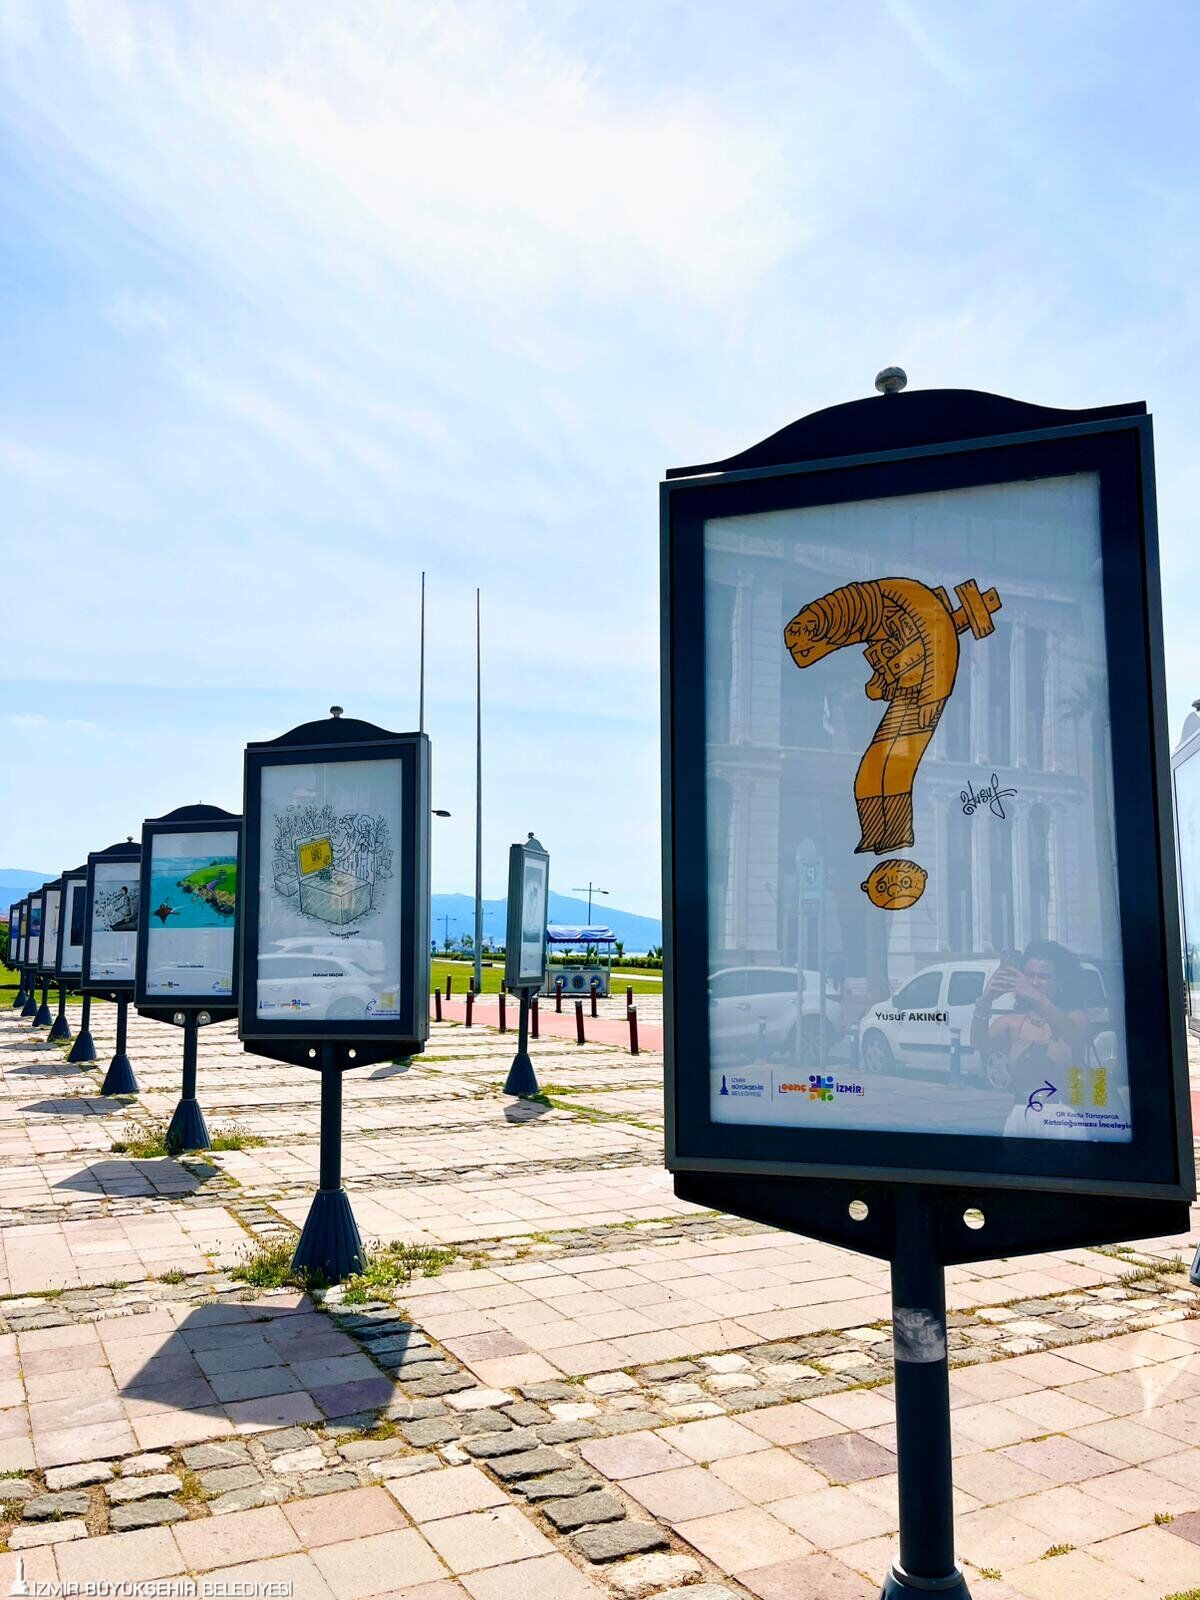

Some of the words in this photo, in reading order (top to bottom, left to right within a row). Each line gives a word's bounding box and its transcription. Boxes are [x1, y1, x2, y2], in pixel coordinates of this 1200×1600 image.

[875, 1011, 906, 1021] Yusuf
[908, 1012, 947, 1022] AKINCI
[836, 1082, 862, 1093] İZMİR
[1085, 1112, 1119, 1121] Tarayarak
[1043, 1119, 1098, 1128] Kataloğumuzu
